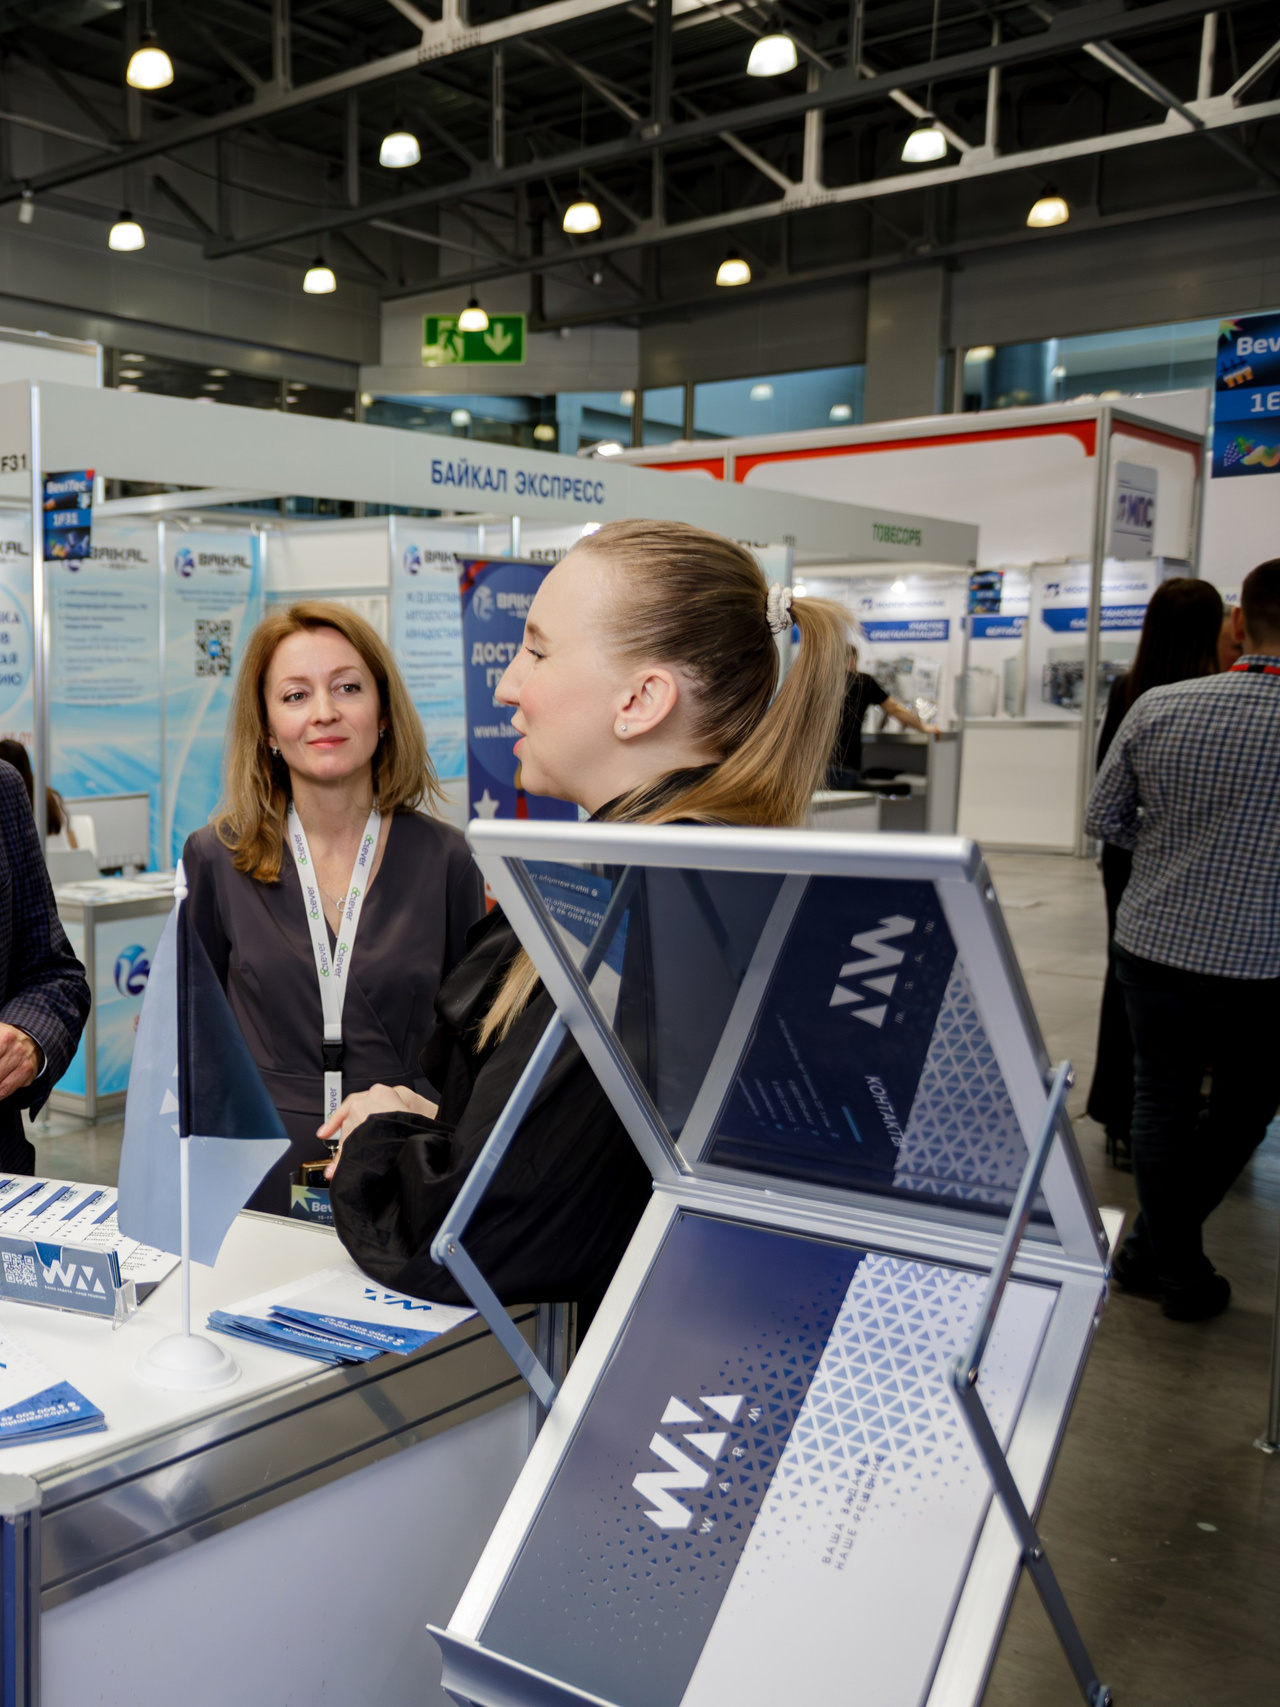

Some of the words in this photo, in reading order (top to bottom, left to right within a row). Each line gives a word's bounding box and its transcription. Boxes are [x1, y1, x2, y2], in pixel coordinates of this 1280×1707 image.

[431, 458, 507, 493] БАЙКАЛ
[515, 471, 605, 505] ЭКСПРЕСС
[198, 552, 252, 569] BAIKAL
[864, 1075, 906, 1148] КОНТАКТЫ
[818, 1520, 847, 1566] ВАША
[837, 1454, 874, 1516] ЗАДАЧА
[831, 1527, 860, 1571] НАШЕ
[848, 1452, 889, 1522] РЕШЕНИЕ
